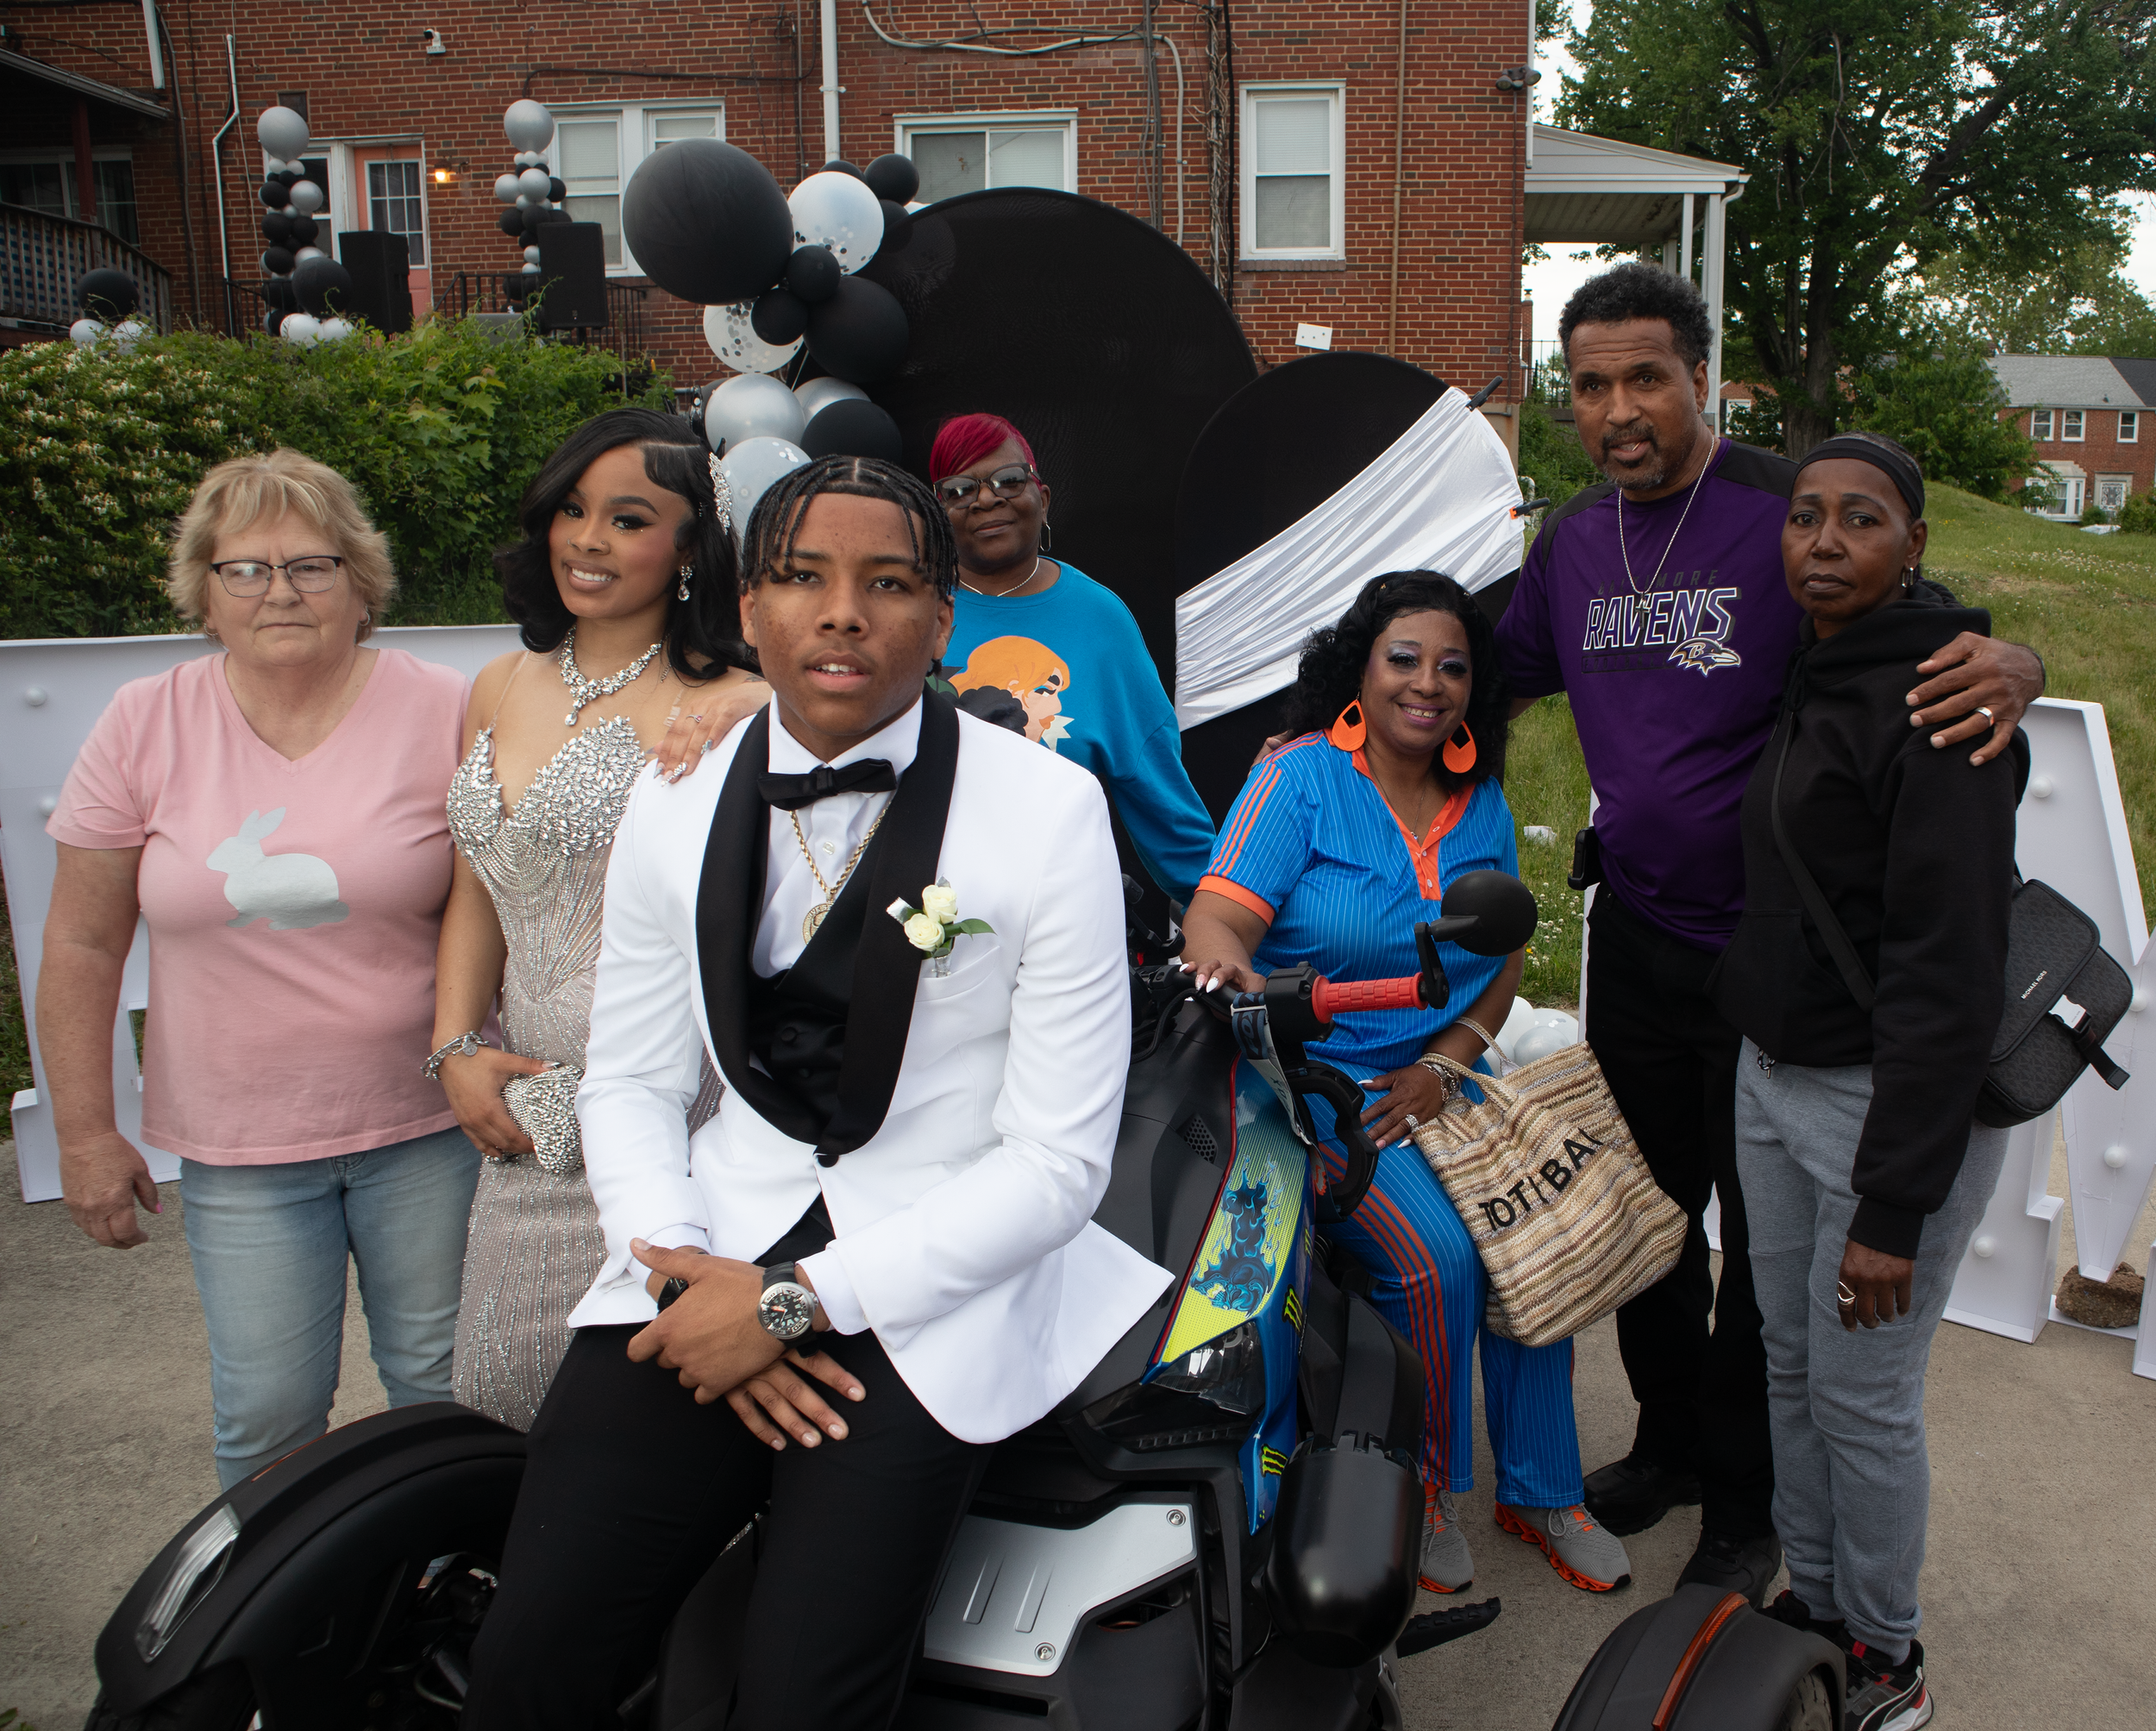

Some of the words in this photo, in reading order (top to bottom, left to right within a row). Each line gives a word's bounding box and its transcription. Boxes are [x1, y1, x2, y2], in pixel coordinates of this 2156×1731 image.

[1583, 587, 1740, 650] RAVENS
[2021, 982, 2038, 999] MICHAEL
[2035, 970, 2047, 982] KORS
